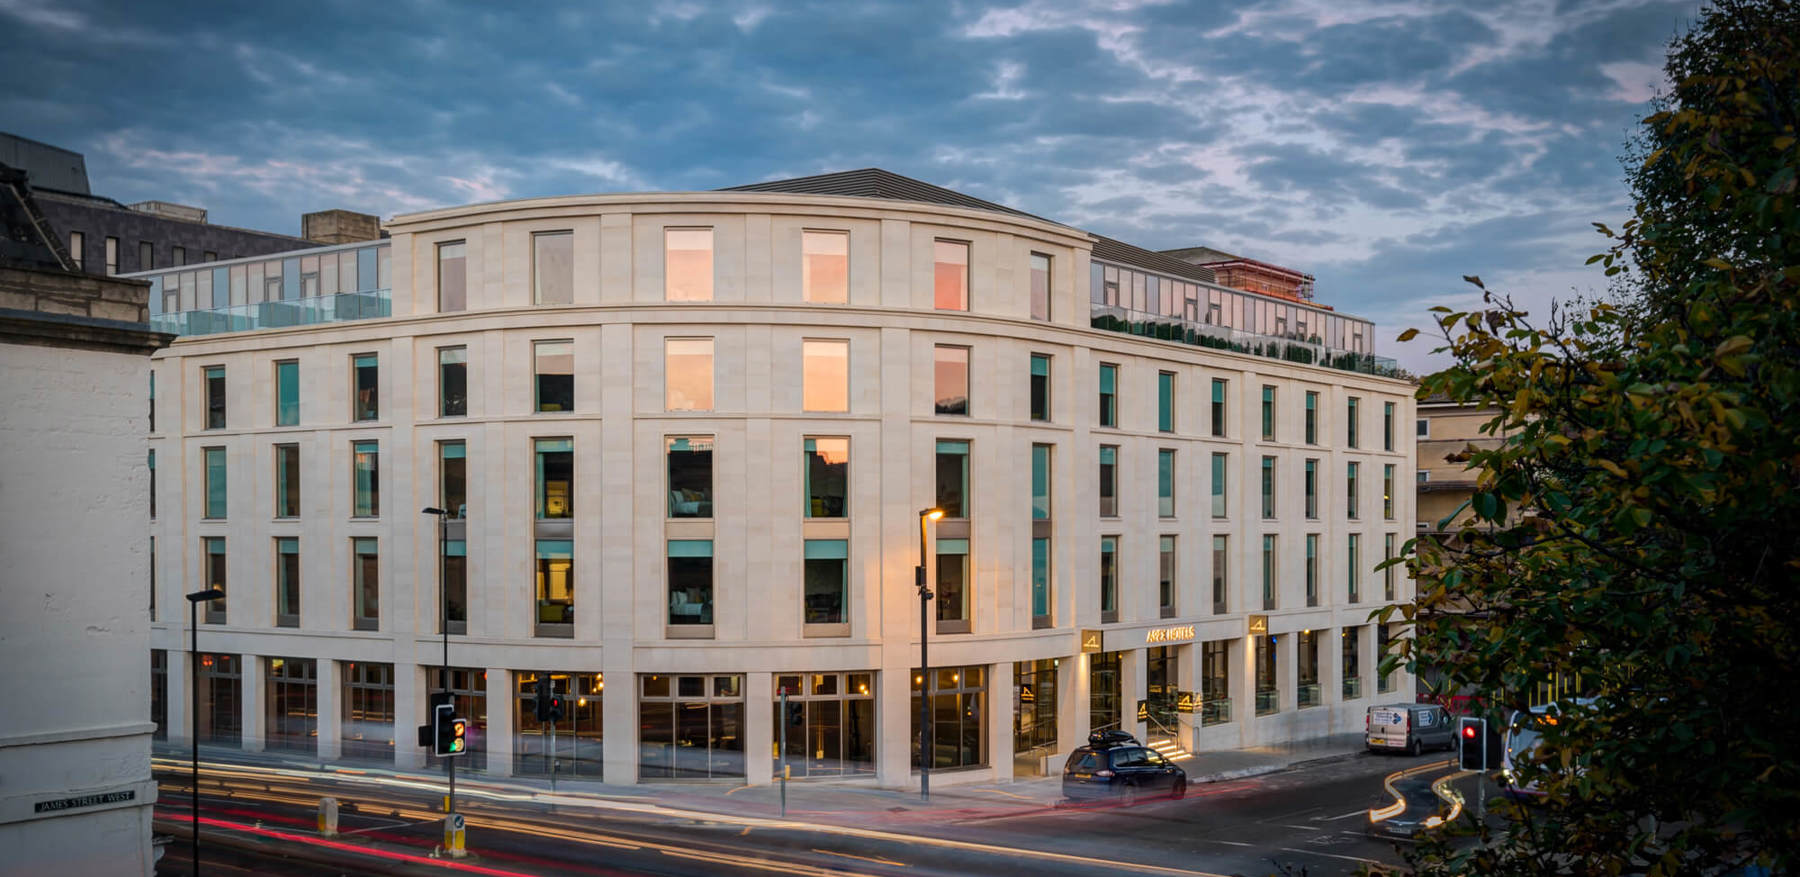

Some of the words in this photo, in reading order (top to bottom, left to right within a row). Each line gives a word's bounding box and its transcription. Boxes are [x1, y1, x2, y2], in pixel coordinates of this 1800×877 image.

[1146, 629, 1166, 643] APEX
[1166, 625, 1195, 641] HOTELS
[41, 798, 69, 810] JAMES
[71, 795, 103, 807] STREET
[107, 791, 130, 802] WEST
